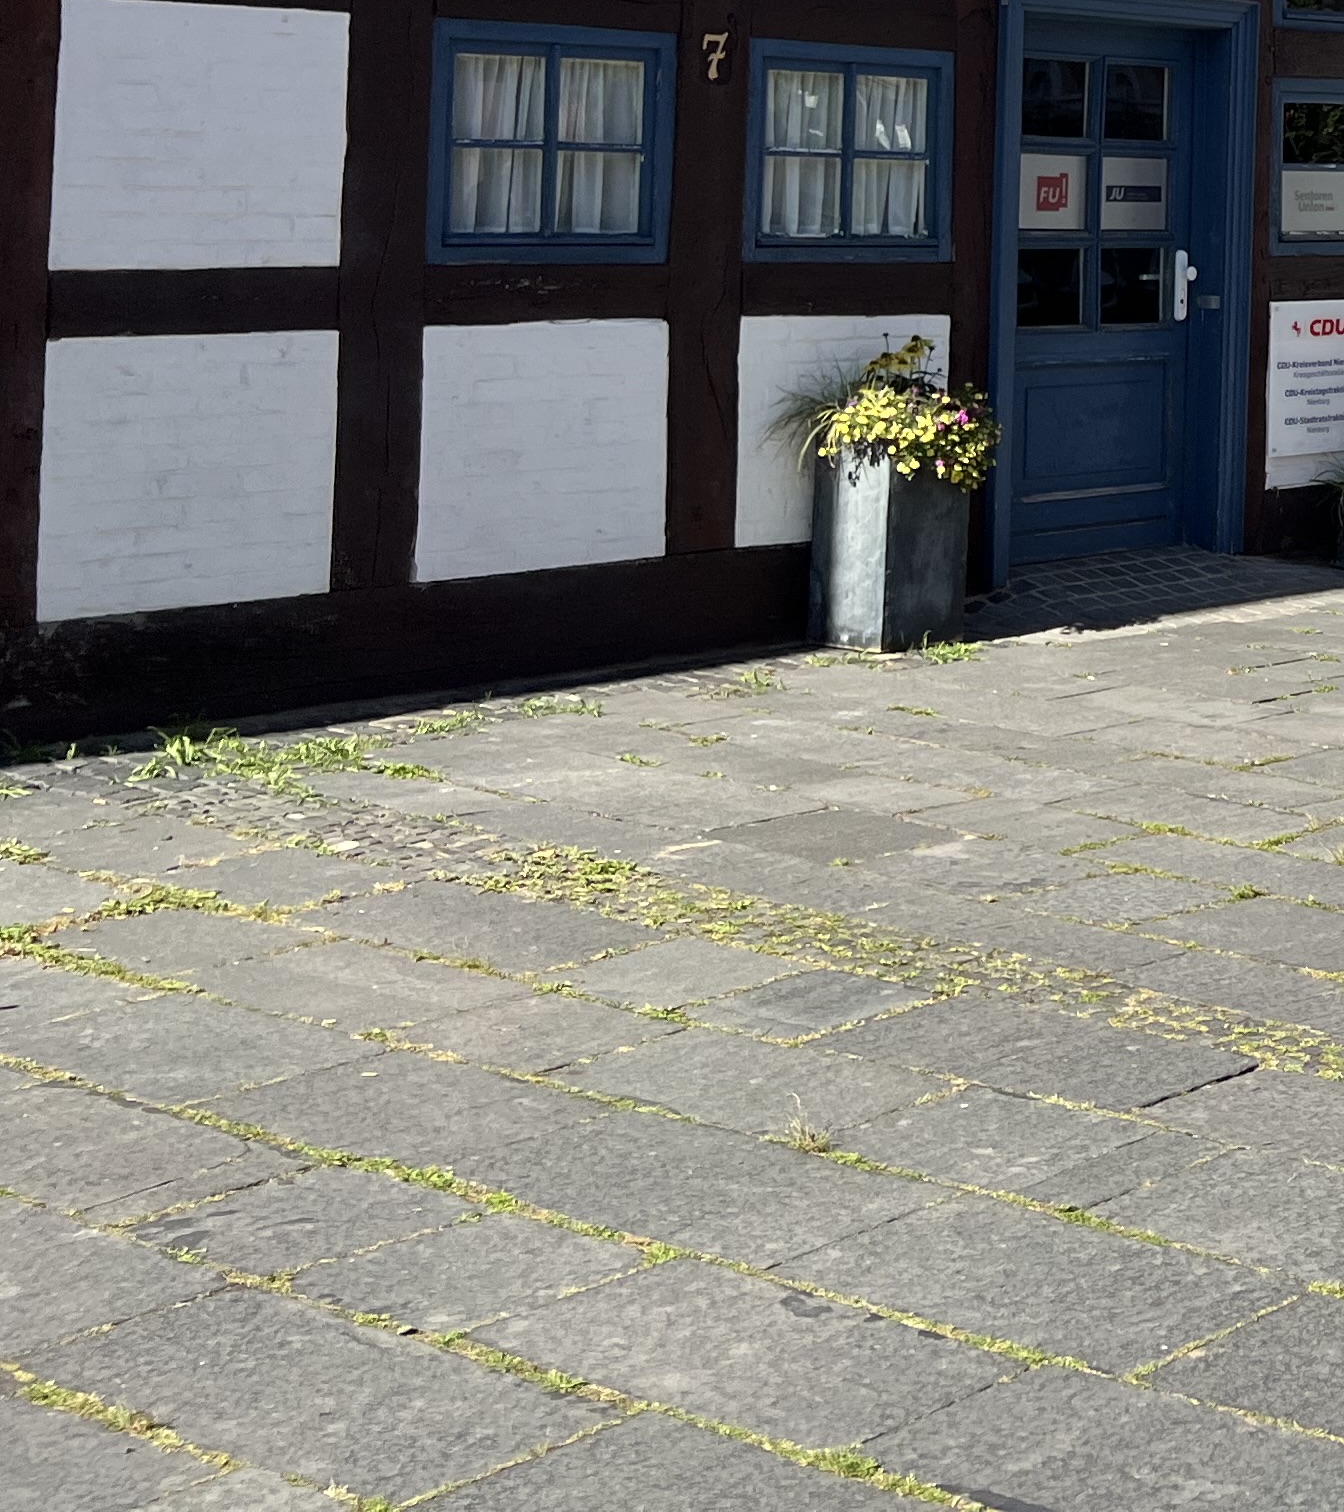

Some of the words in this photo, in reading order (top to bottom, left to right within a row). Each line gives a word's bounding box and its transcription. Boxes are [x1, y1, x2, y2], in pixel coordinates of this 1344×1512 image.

[702, 31, 729, 80] 7
[1109, 187, 1125, 200] JU
[1294, 190, 1334, 201] Senioren
[1298, 201, 1325, 212] Union
